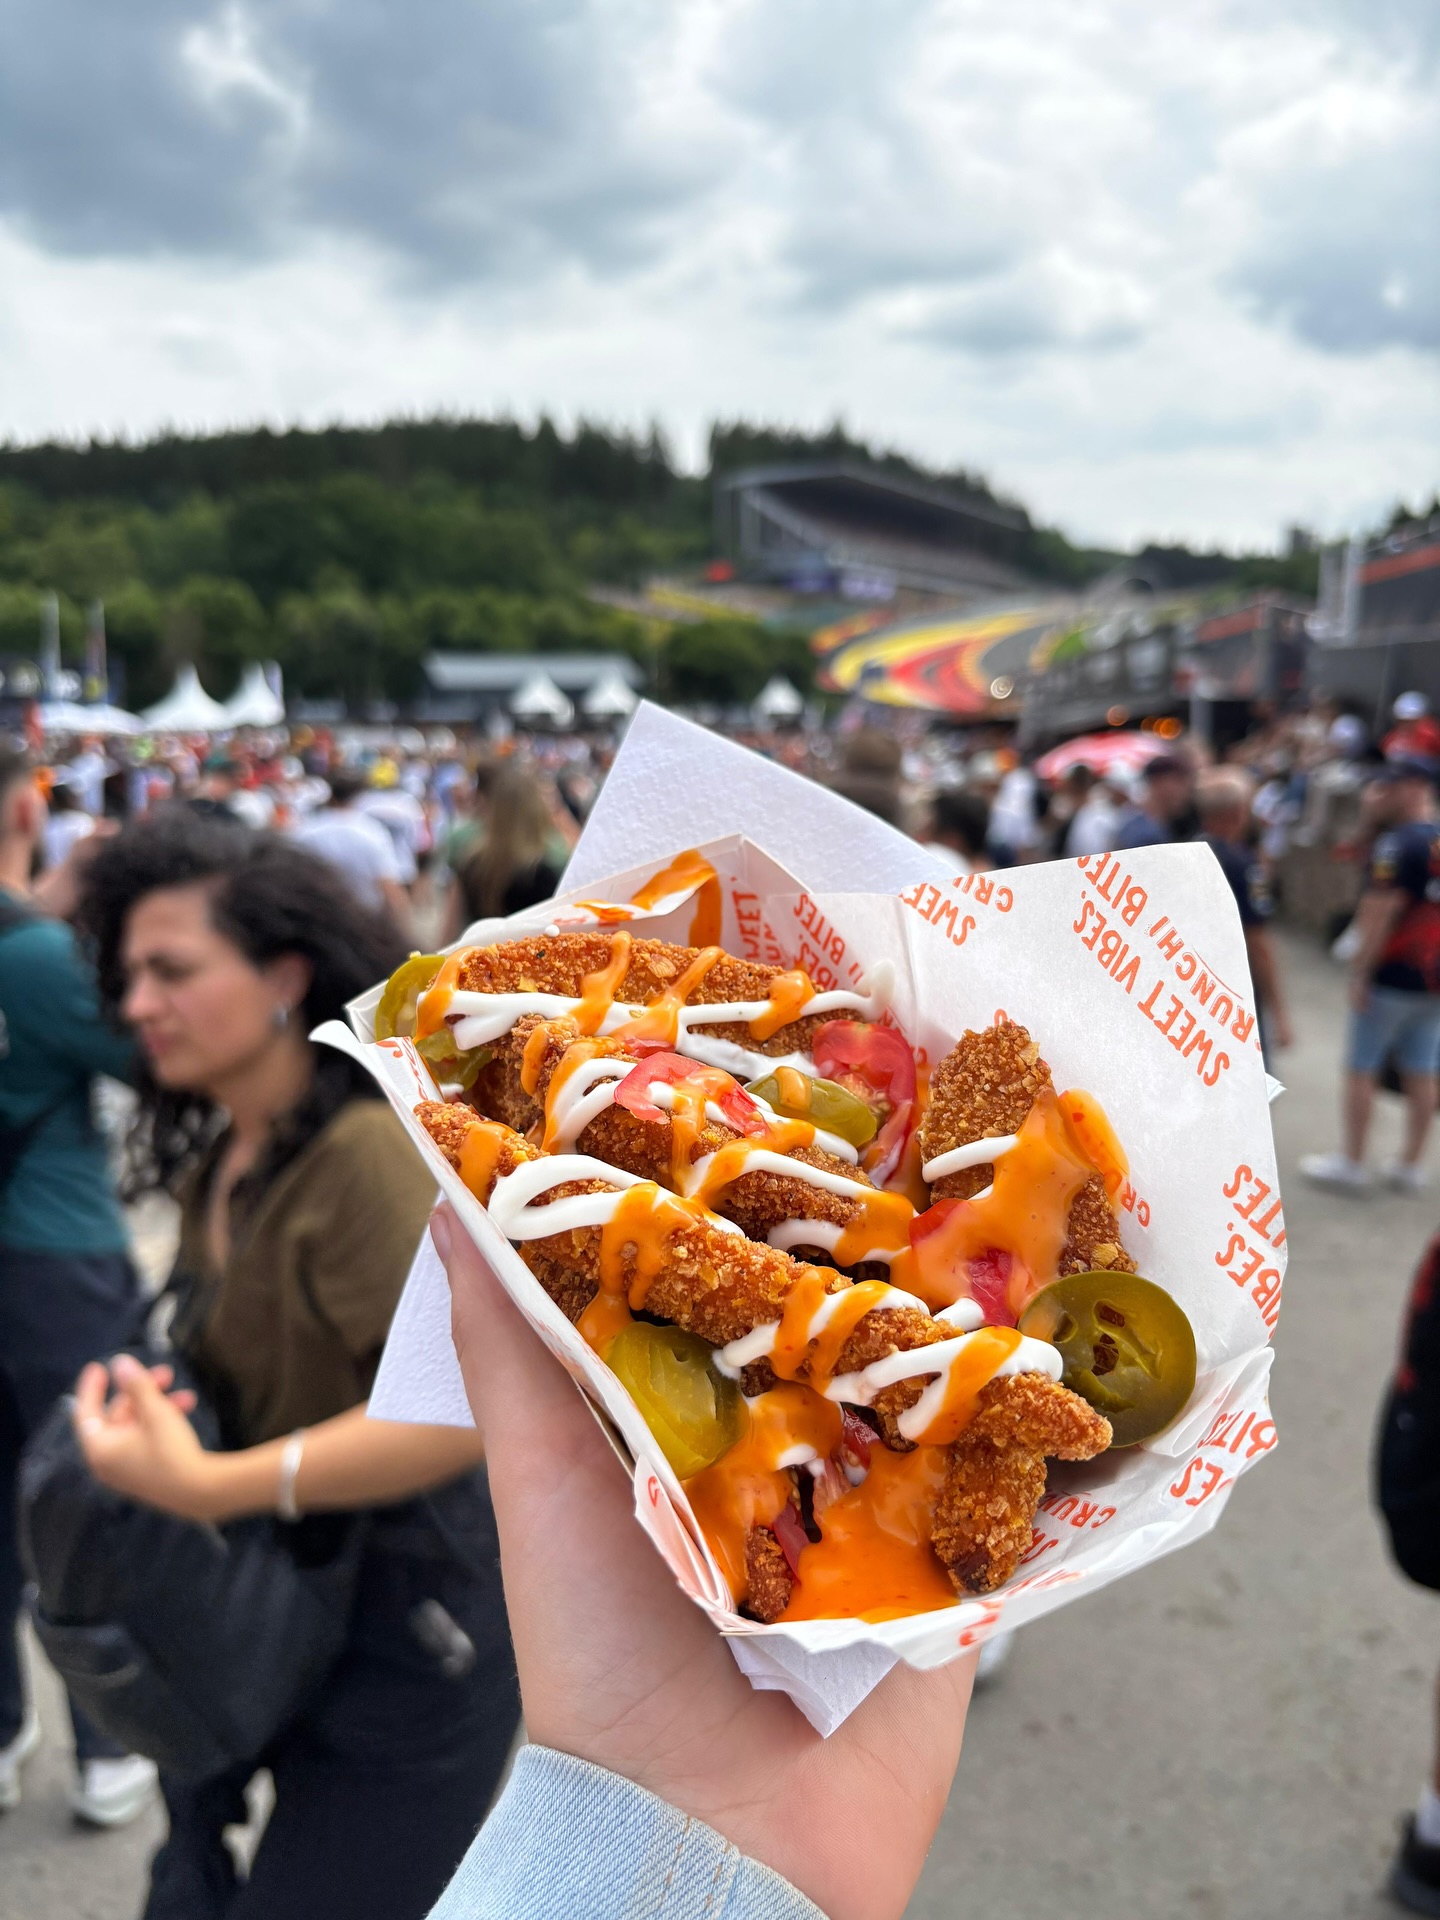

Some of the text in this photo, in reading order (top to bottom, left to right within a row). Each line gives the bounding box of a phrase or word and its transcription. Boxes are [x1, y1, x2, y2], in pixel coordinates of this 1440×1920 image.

[732, 891, 761, 959] WEET
[793, 894, 846, 966] BITES
[899, 883, 976, 946] SWEE
[1073, 889, 1231, 1087] SWEET VIBES.
[1150, 915, 1263, 1051] RUNCHI
[1222, 1164, 1286, 1249] ITES
